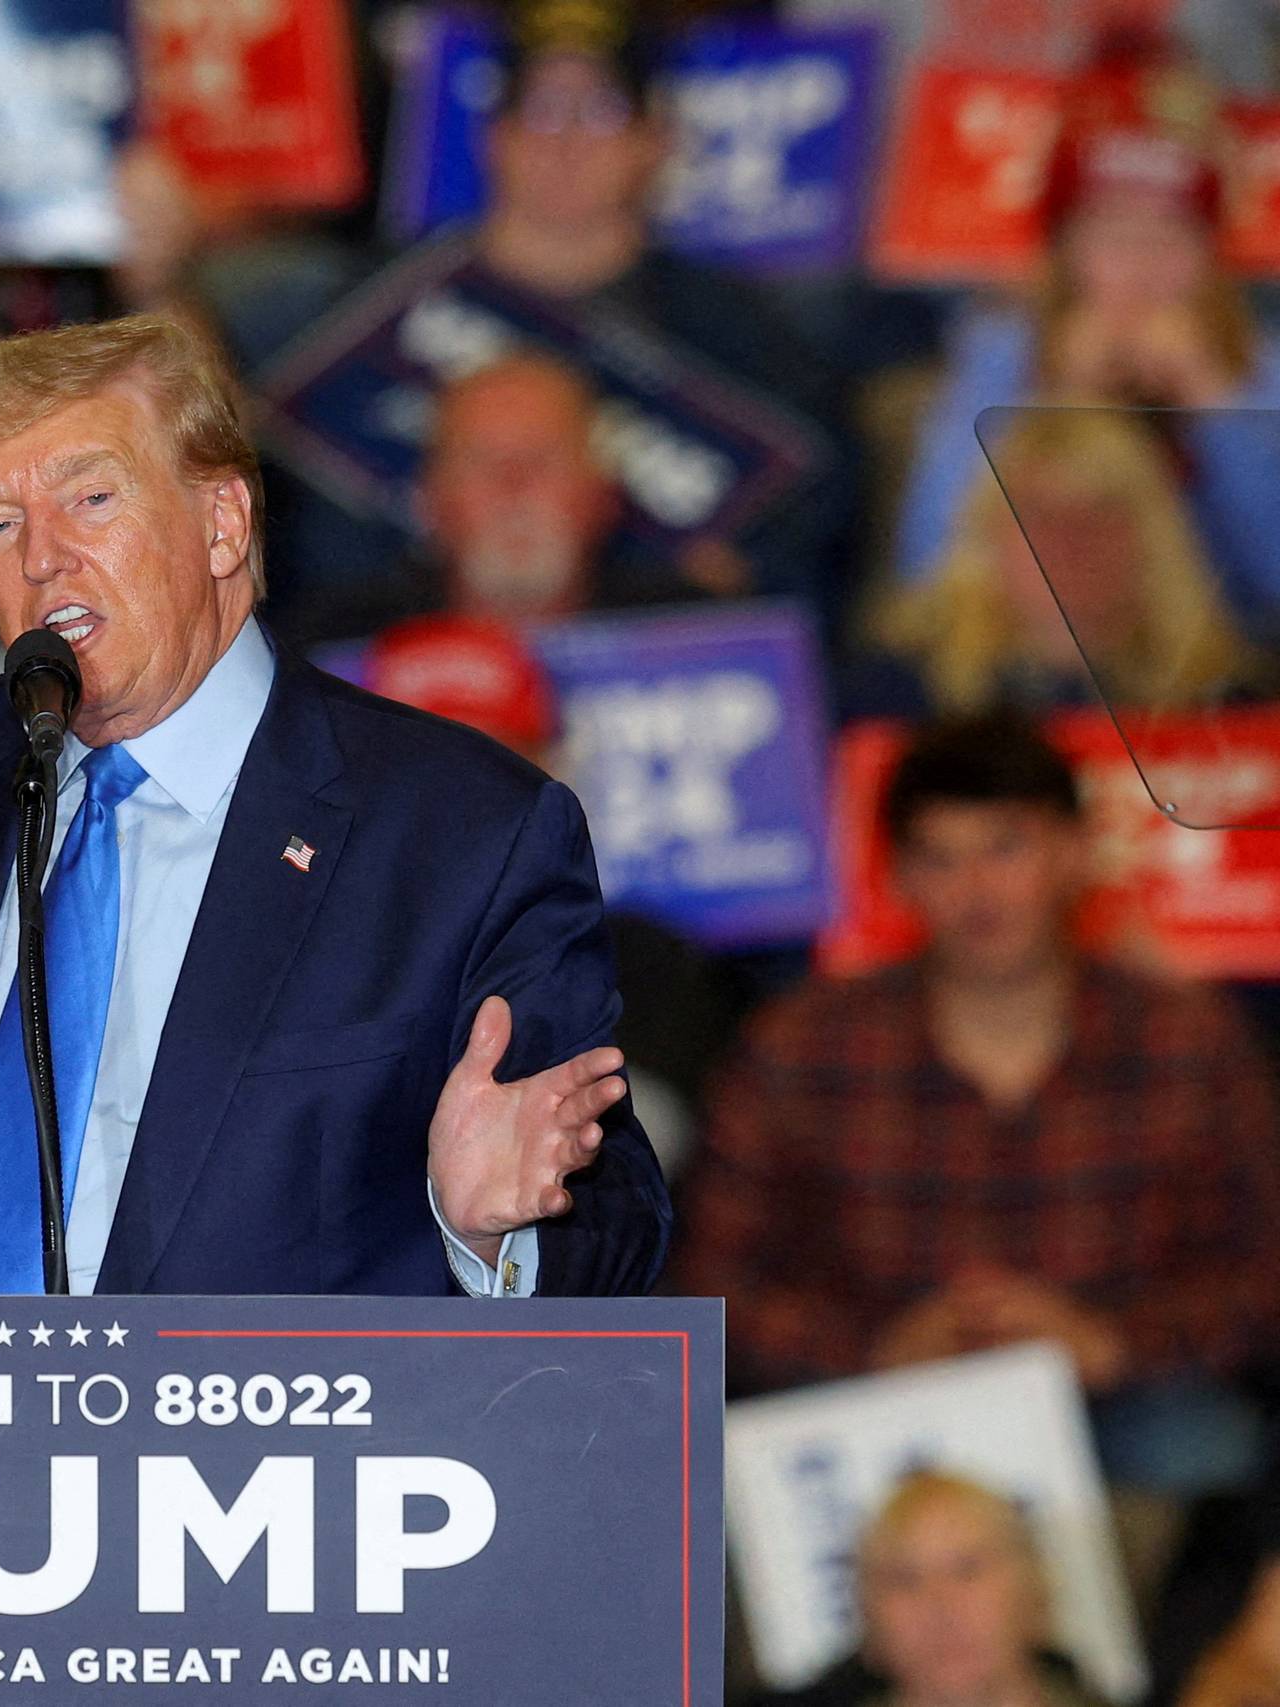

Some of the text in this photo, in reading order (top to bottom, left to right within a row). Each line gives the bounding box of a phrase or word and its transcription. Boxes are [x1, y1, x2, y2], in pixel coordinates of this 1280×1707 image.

[37, 1374, 128, 1425] TO
[155, 1374, 372, 1425] 88022
[68, 1648, 240, 1682] GREAT
[262, 1648, 449, 1683] AGAIN!
